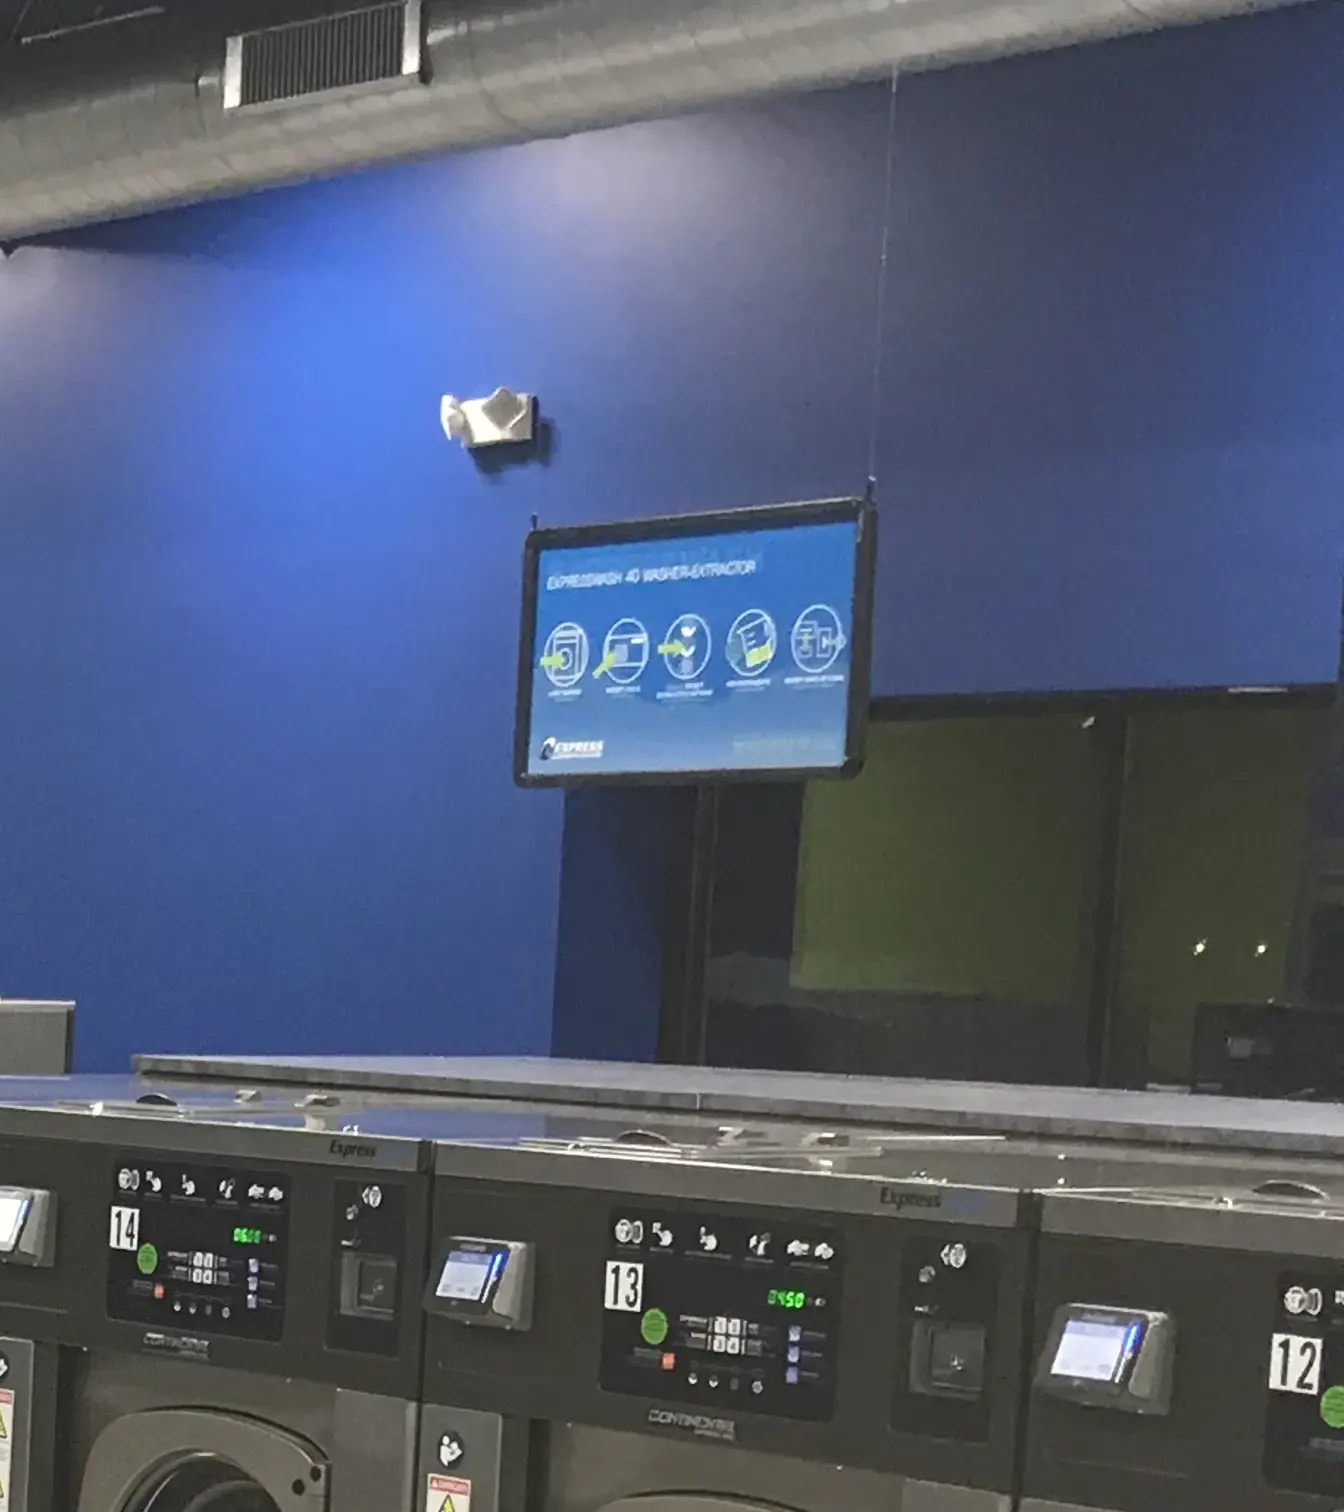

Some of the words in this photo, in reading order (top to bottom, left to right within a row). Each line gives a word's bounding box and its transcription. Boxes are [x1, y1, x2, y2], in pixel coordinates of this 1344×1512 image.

[330, 1139, 376, 1157] Express
[114, 1209, 135, 1248] 14
[611, 1265, 639, 1307] 13
[1278, 1338, 1317, 1390] 12
